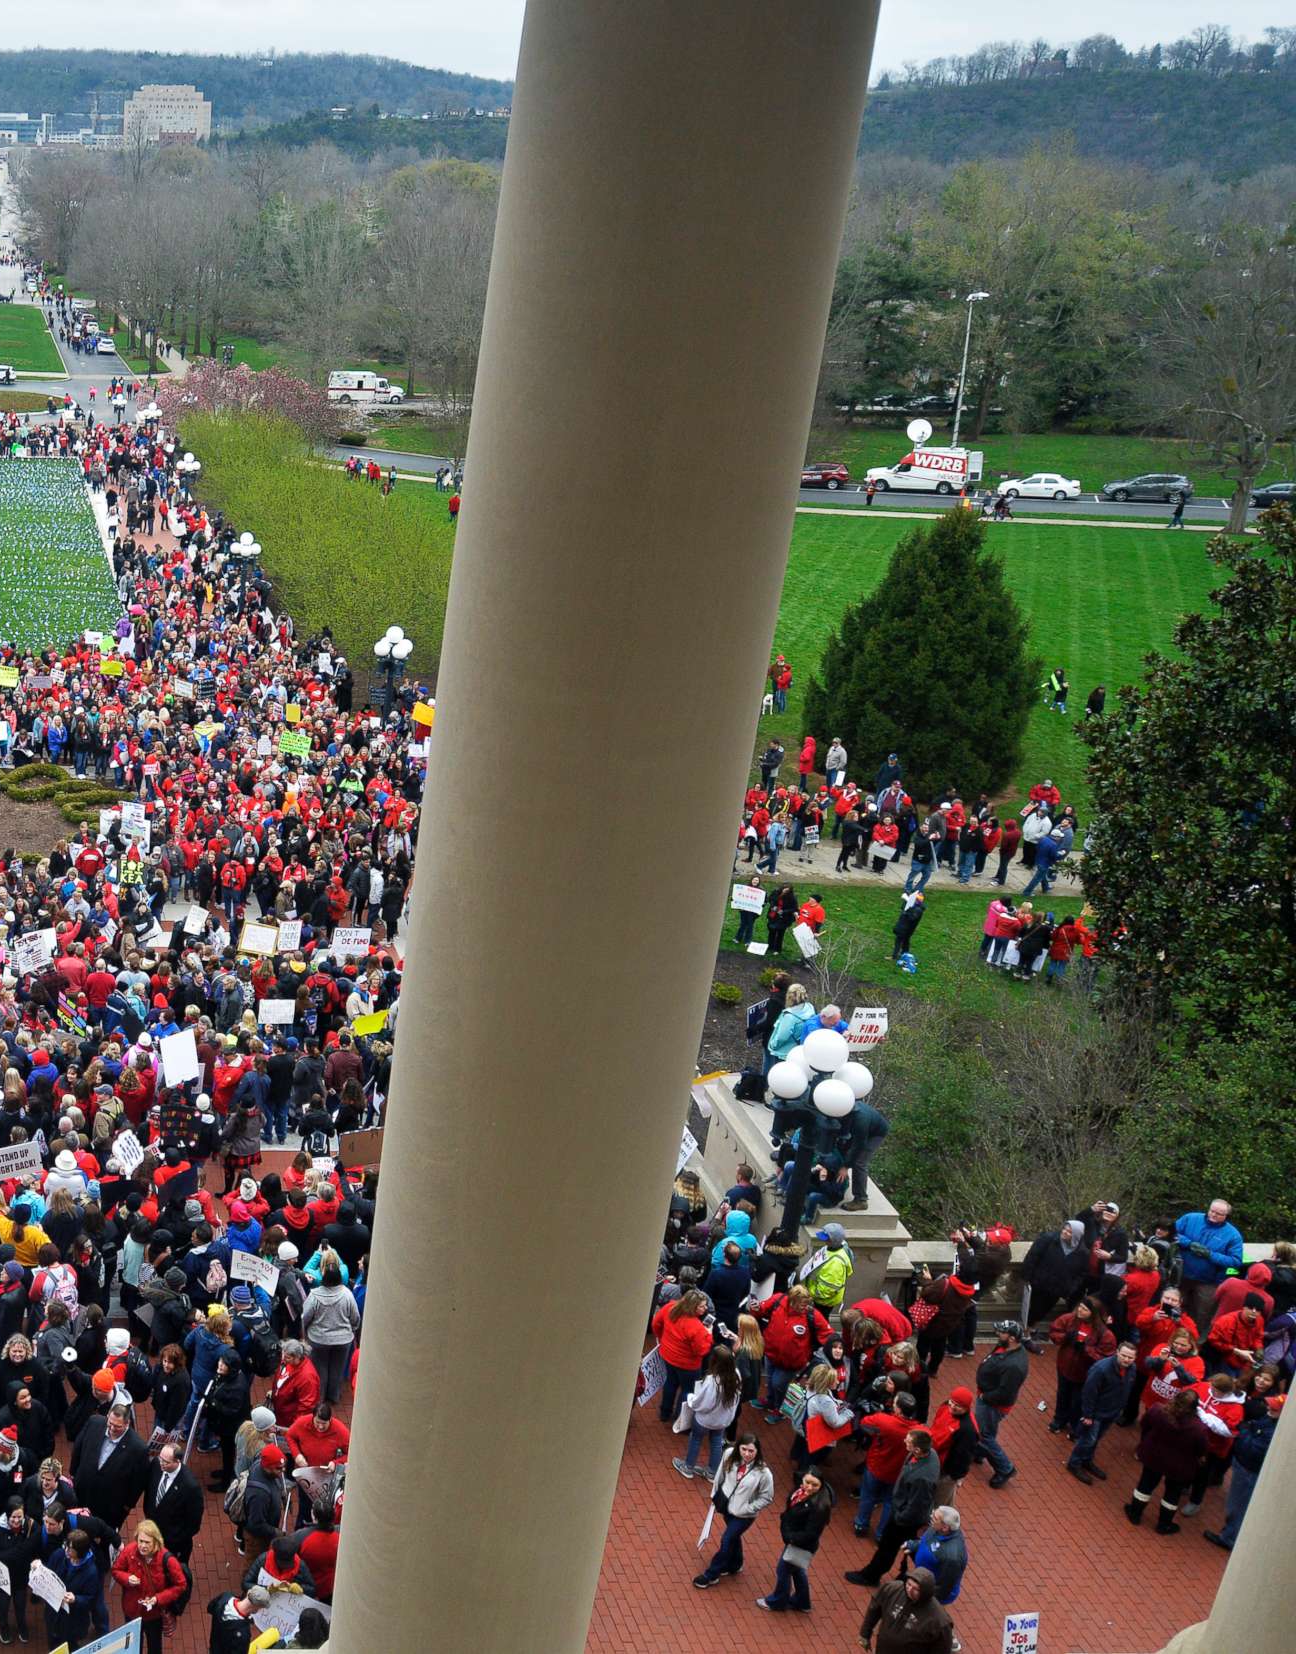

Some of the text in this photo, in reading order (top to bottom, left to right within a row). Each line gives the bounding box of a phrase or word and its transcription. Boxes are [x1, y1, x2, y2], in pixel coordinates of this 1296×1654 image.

[914, 454, 964, 472] WDRB
[937, 472, 959, 480] NEWS
[120, 873, 144, 884] KEA
[860, 1025, 880, 1033] FIND
[20, 1149, 29, 1158] UP
[15, 1159, 37, 1171] BACK!
[1024, 1644, 1036, 1653] CAN
